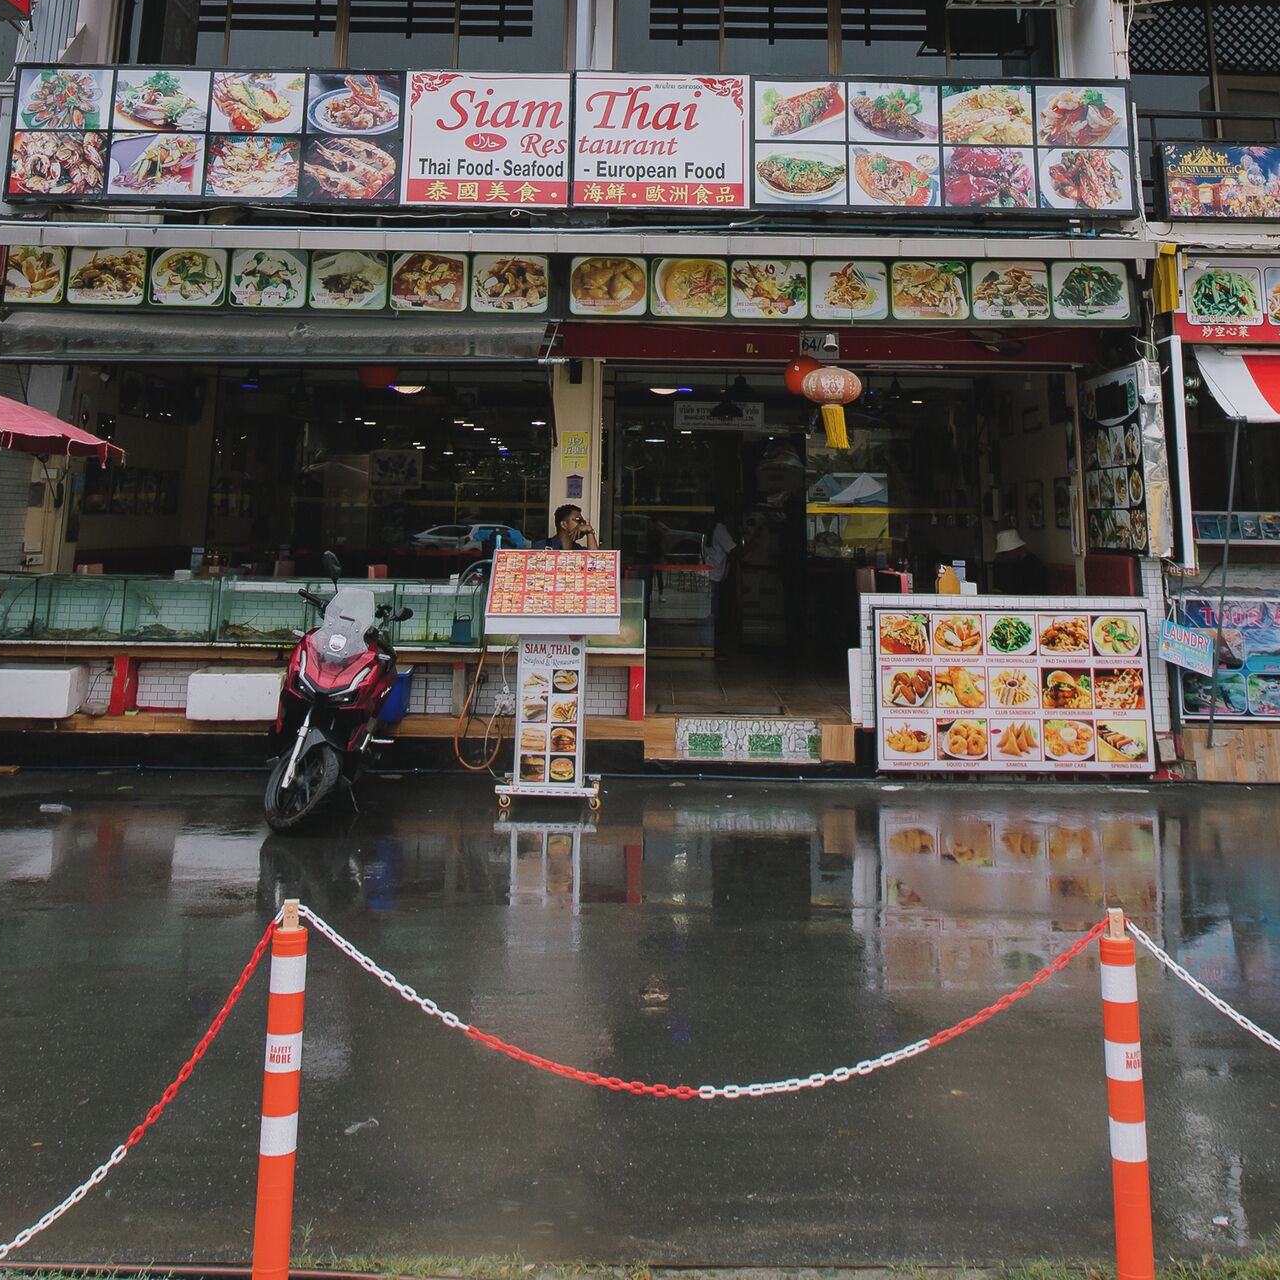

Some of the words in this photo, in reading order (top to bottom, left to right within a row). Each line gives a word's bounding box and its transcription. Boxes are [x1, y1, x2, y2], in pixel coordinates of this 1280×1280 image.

[436, 88, 564, 131] Siam
[585, 85, 703, 131] Thai
[419, 158, 451, 176] Thai
[596, 161, 677, 182] European
[684, 162, 725, 179] Food
[1168, 164, 1211, 174] CARNIVAL
[1202, 325, 1249, 338] 炒空心菜
[1200, 607, 1265, 629] TOUR
[1163, 622, 1210, 651] LAUNDRY
[524, 643, 547, 654] SIAM
[550, 643, 571, 655] THAI
[269, 1053, 292, 1064] MORE
